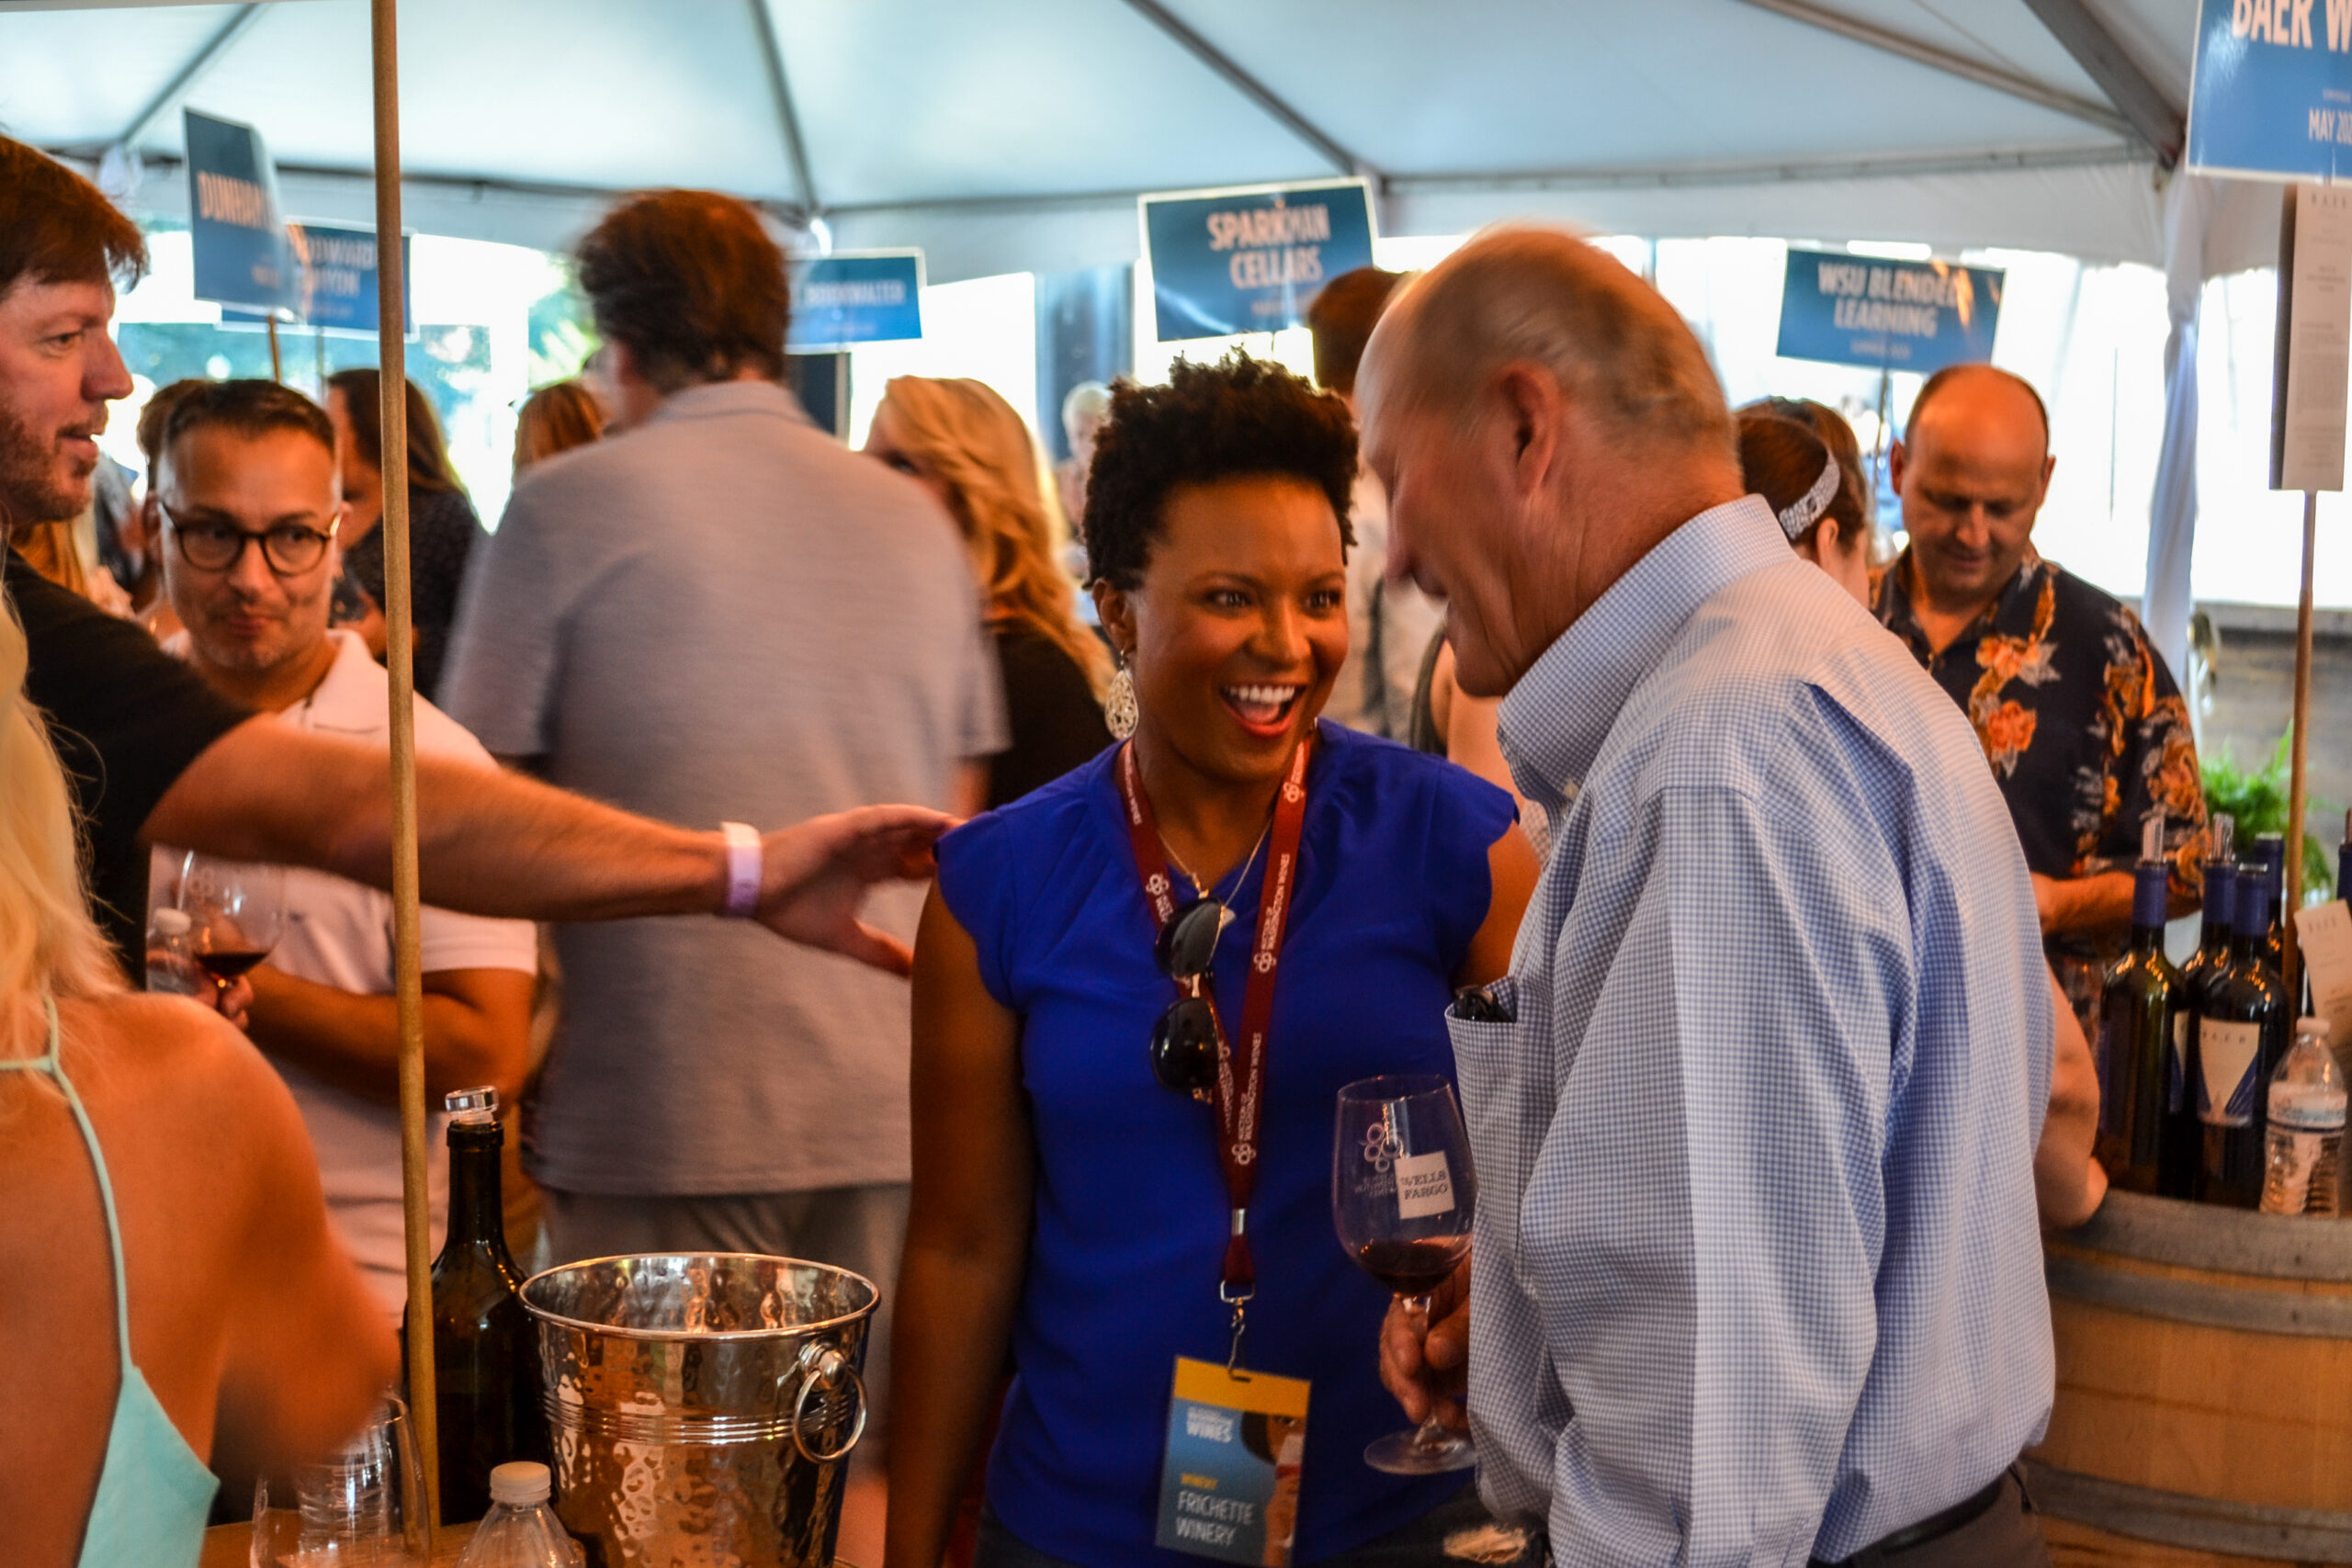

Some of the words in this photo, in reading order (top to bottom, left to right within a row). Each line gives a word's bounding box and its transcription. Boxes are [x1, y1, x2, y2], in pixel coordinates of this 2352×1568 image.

[2309, 107, 2335, 142] MAY
[1206, 203, 1332, 252] SPARKMAN
[1229, 245, 1324, 290] CELLARS
[1818, 262, 1866, 297] WSU
[1834, 297, 1939, 339] LEARNING
[1401, 1170, 1448, 1187] WELLS
[1404, 1183, 1449, 1200] FARGO
[1178, 1490, 1255, 1525] FRICHETTE
[1177, 1517, 1236, 1547] WINERY
